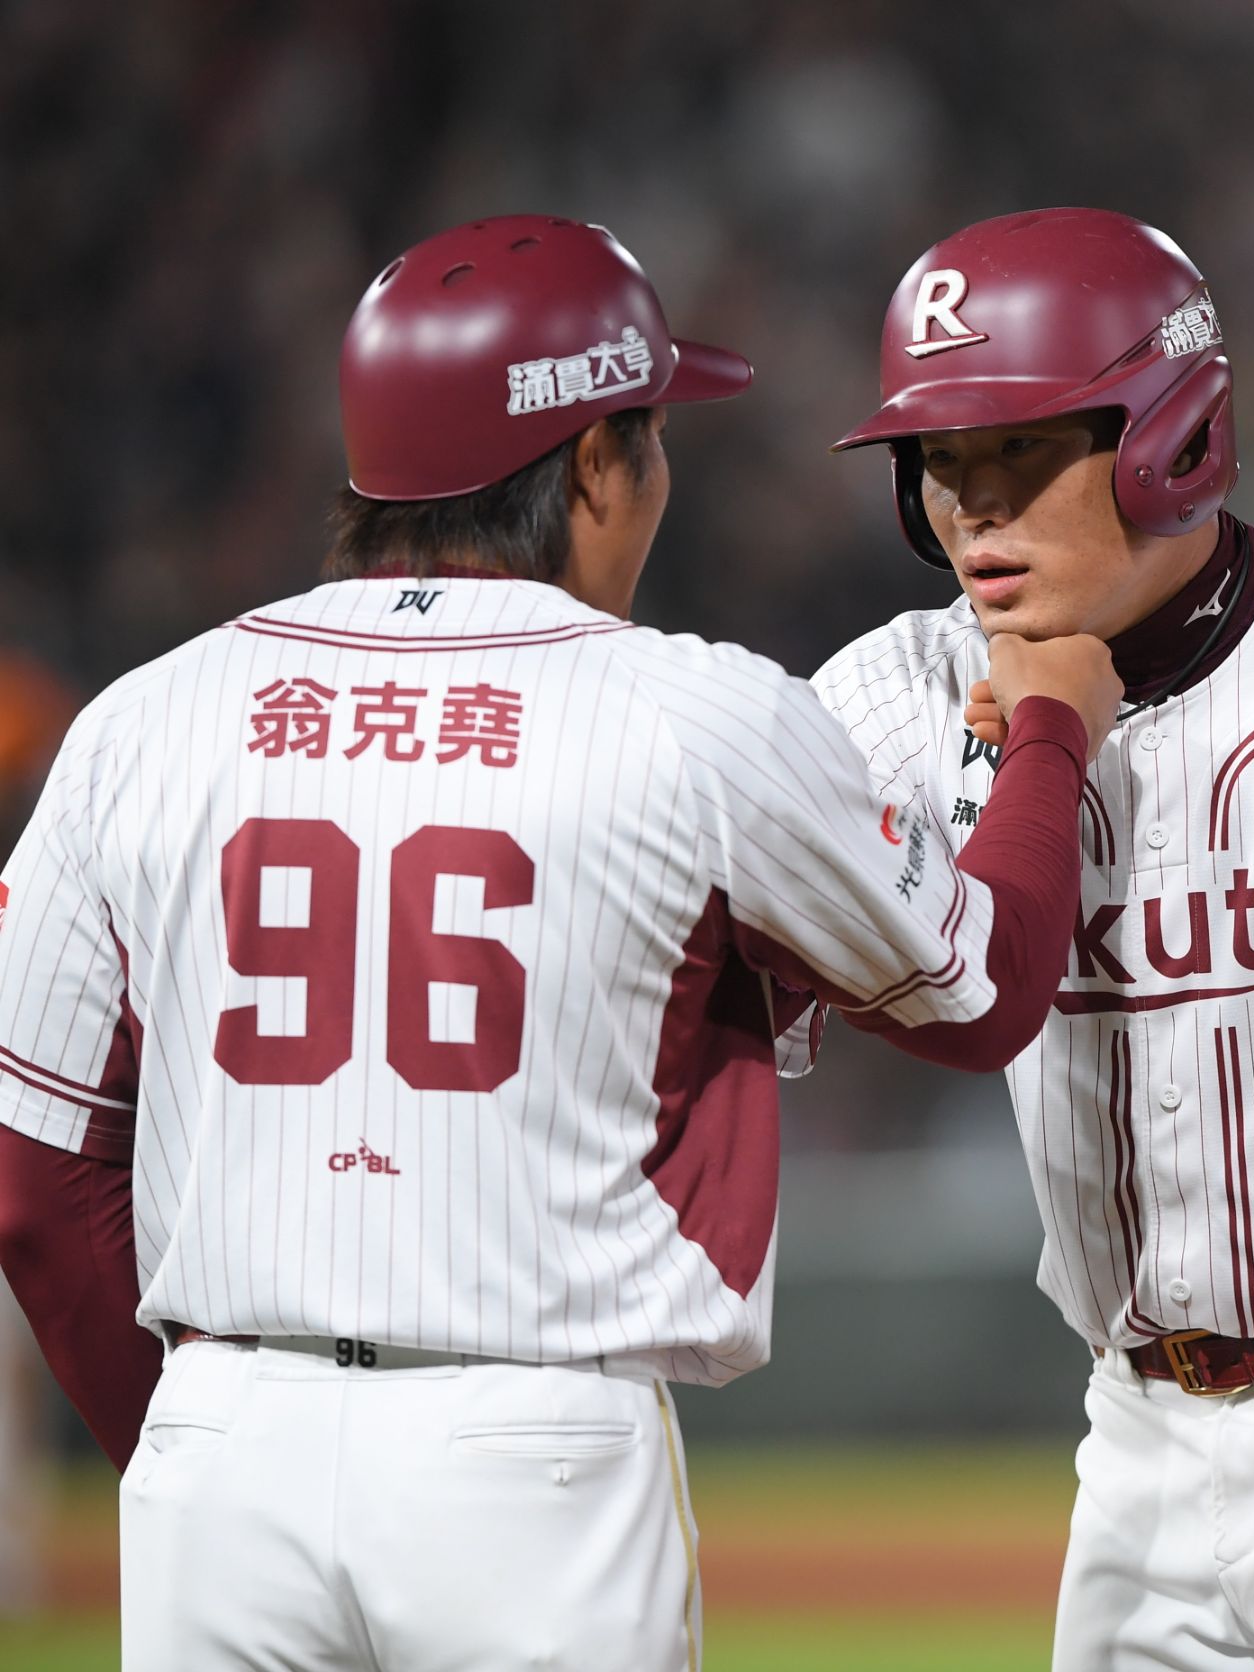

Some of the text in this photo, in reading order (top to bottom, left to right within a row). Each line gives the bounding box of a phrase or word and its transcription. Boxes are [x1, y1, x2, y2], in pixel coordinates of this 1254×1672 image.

[911, 268, 973, 344] R
[1161, 293, 1222, 358] 滿貫大
[508, 326, 652, 415] 滿貫大亨
[247, 678, 523, 768] 翁克堯
[951, 797, 985, 826] 滿
[213, 817, 535, 1094] 96
[328, 1152, 401, 1175] CPBL
[336, 1337, 377, 1368] 96
